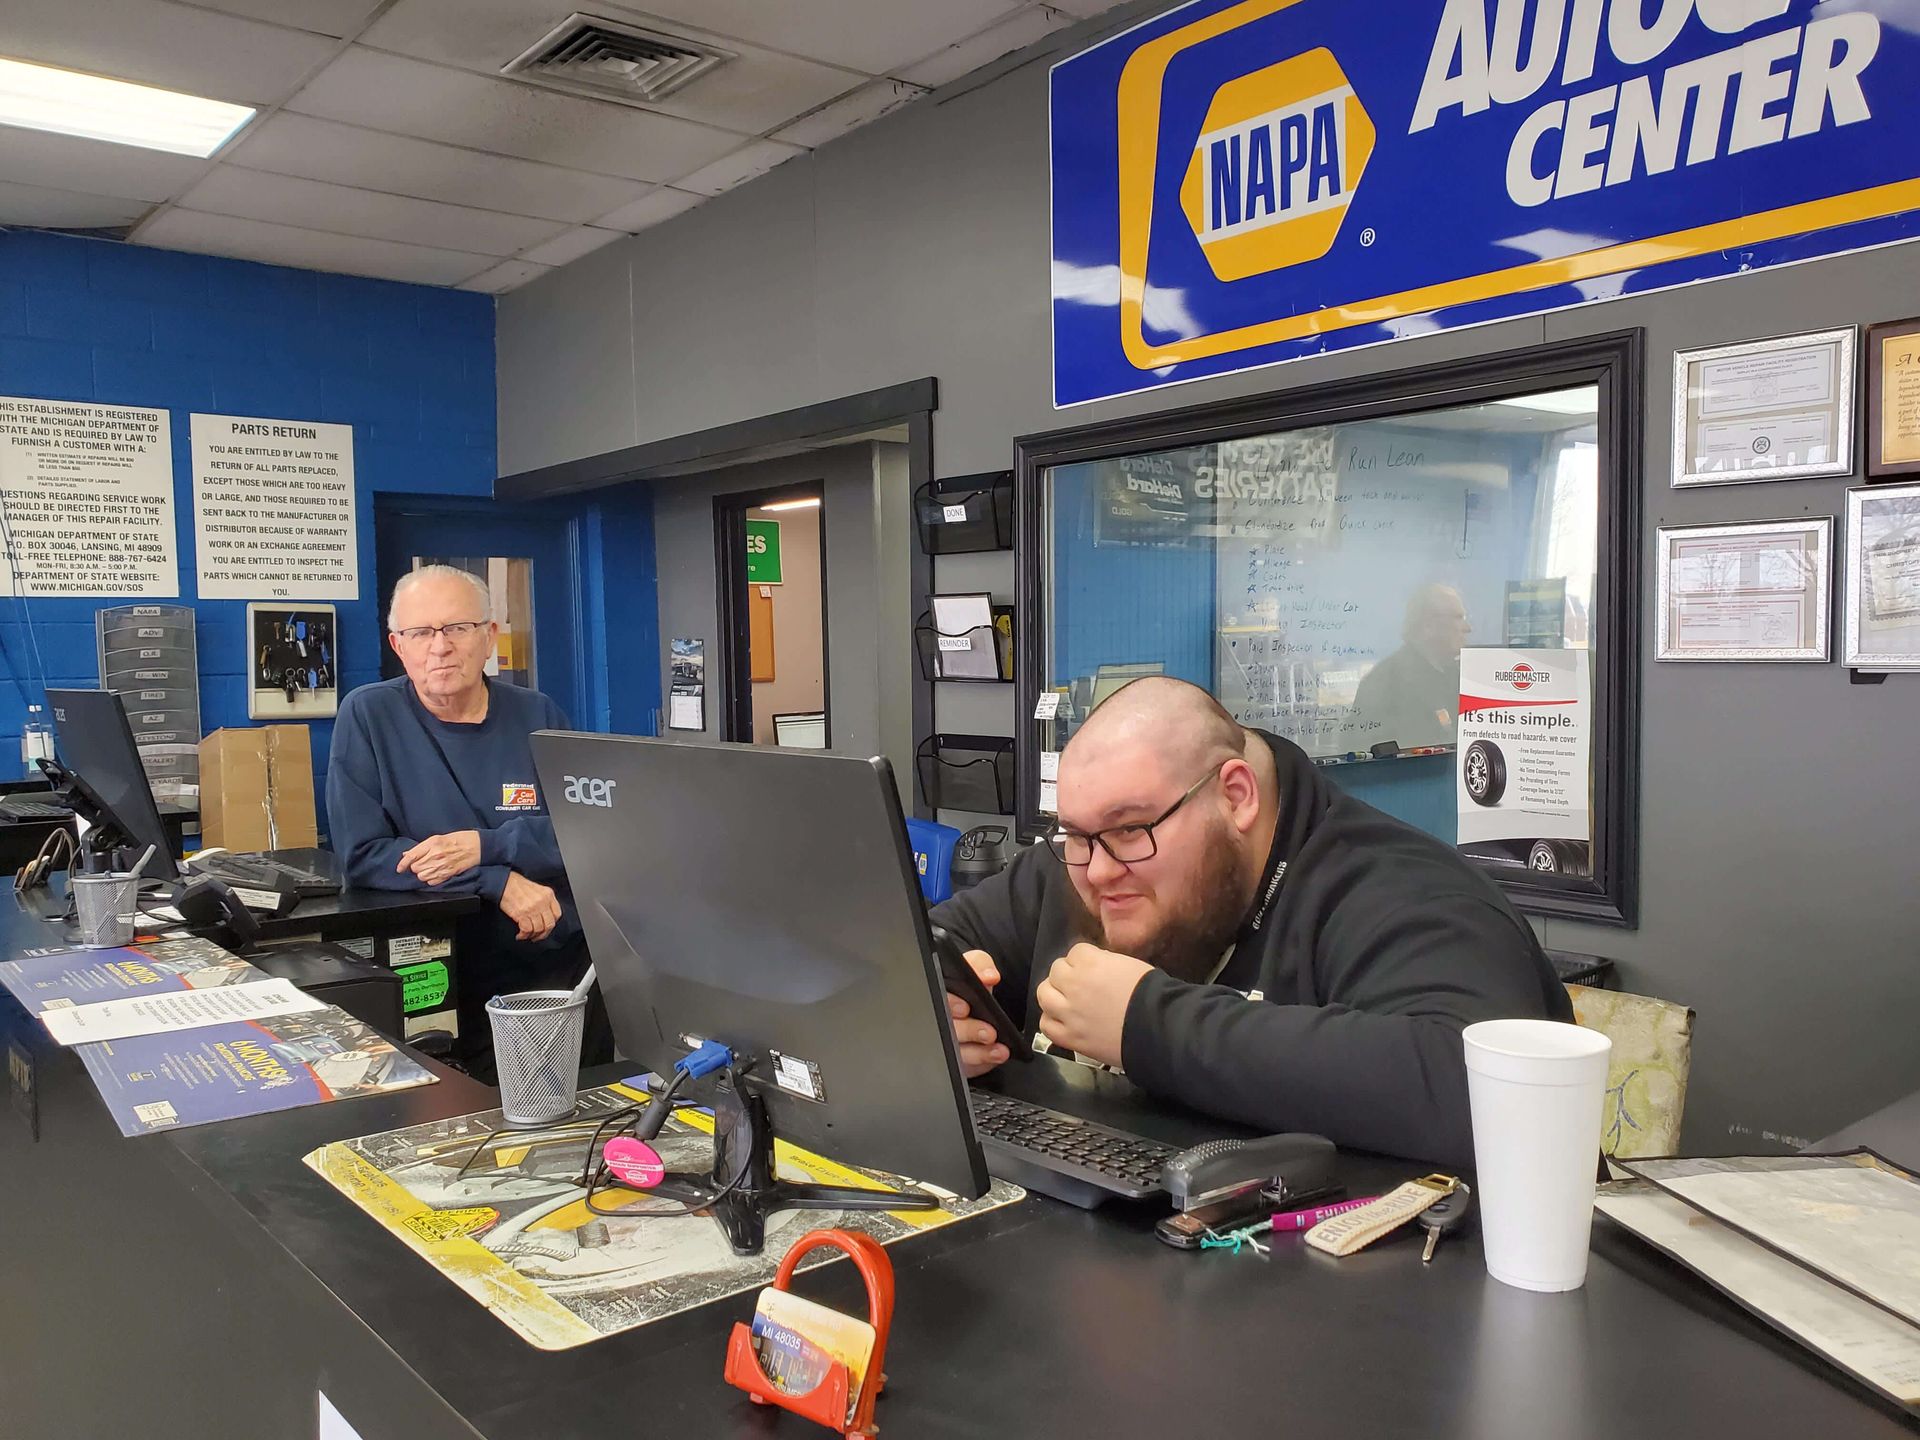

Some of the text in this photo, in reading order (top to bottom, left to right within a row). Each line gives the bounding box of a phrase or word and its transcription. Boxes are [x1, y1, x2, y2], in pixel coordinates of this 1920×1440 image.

[1505, 11, 1881, 207] CENTER
[1211, 102, 1341, 230] NAPA
[17, 404, 91, 417] ESTABLISHMENT
[94, 410, 103, 418] IS
[105, 410, 158, 422] REGISTERED
[21, 416, 37, 425] THE
[40, 417, 86, 428] MICHIGAN
[88, 420, 145, 432] DEPARTMENT
[148, 424, 159, 432] OF
[0, 425, 157, 443] STATE AND IS REQUIRED BY LAW TO
[232, 424, 316, 439] PARTS RETURN
[11, 437, 146, 453] FURNISH A CUSTOMER WITH A:
[209, 446, 225, 454] YOU
[227, 447, 243, 455] ARE
[244, 448, 281, 457] ENTITLED
[294, 450, 312, 459] LAW
[314, 451, 323, 459] TO
[325, 452, 338, 460] THE
[210, 462, 242, 470] RETURN
[255, 464, 269, 472] ALL
[271, 465, 297, 474] PARTS
[298, 466, 338, 476] REPLACED,
[204, 477, 232, 485] EXCEPT
[236, 479, 260, 487] THOSE
[262, 480, 287, 488] WHICH
[322, 483, 346, 491] HEAVY
[48, 492, 100, 502] REGARDING
[102, 494, 138, 503] SERVICE
[140, 496, 166, 504] WORK
[214, 494, 242, 502] LARGE,
[244, 495, 261, 503] AND
[264, 496, 288, 504] THOSE
[289, 496, 326, 505] REQUIRED
[4, 502, 40, 511] SHOULD
[57, 504, 101, 513] DIRECTED
[103, 505, 127, 514] FIRST
[144, 507, 159, 515] THE
[946, 508, 964, 518] DONE
[4, 513, 163, 525] MANAGER OF THIS REPAIR FACILITY.
[276, 511, 337, 521] MANUFACTURER
[9, 531, 158, 541] MICHIGAN DEPARTMENT OF STATE
[206, 525, 257, 534] DISTRIBUTOR
[6, 541, 162, 552] P.O. BOX 30046, LANSING, MI 48909
[2, 552, 167, 562] TOLL-FREE TELEPHONE: 888-767-6424
[940, 639, 969, 648] REMINDER
[1495, 672, 1550, 682] RUBBERMASTER
[1464, 710, 1575, 729] It's this simple.
[1463, 730, 1477, 738] From
[1479, 731, 1499, 739] defects
[1522, 734, 1548, 742] hazards,
[564, 775, 617, 808] acer
[1316, 1213, 1364, 1244] ENJOY
[1392, 1188, 1427, 1215] RIDE
[762, 1325, 801, 1350] MI 48035
